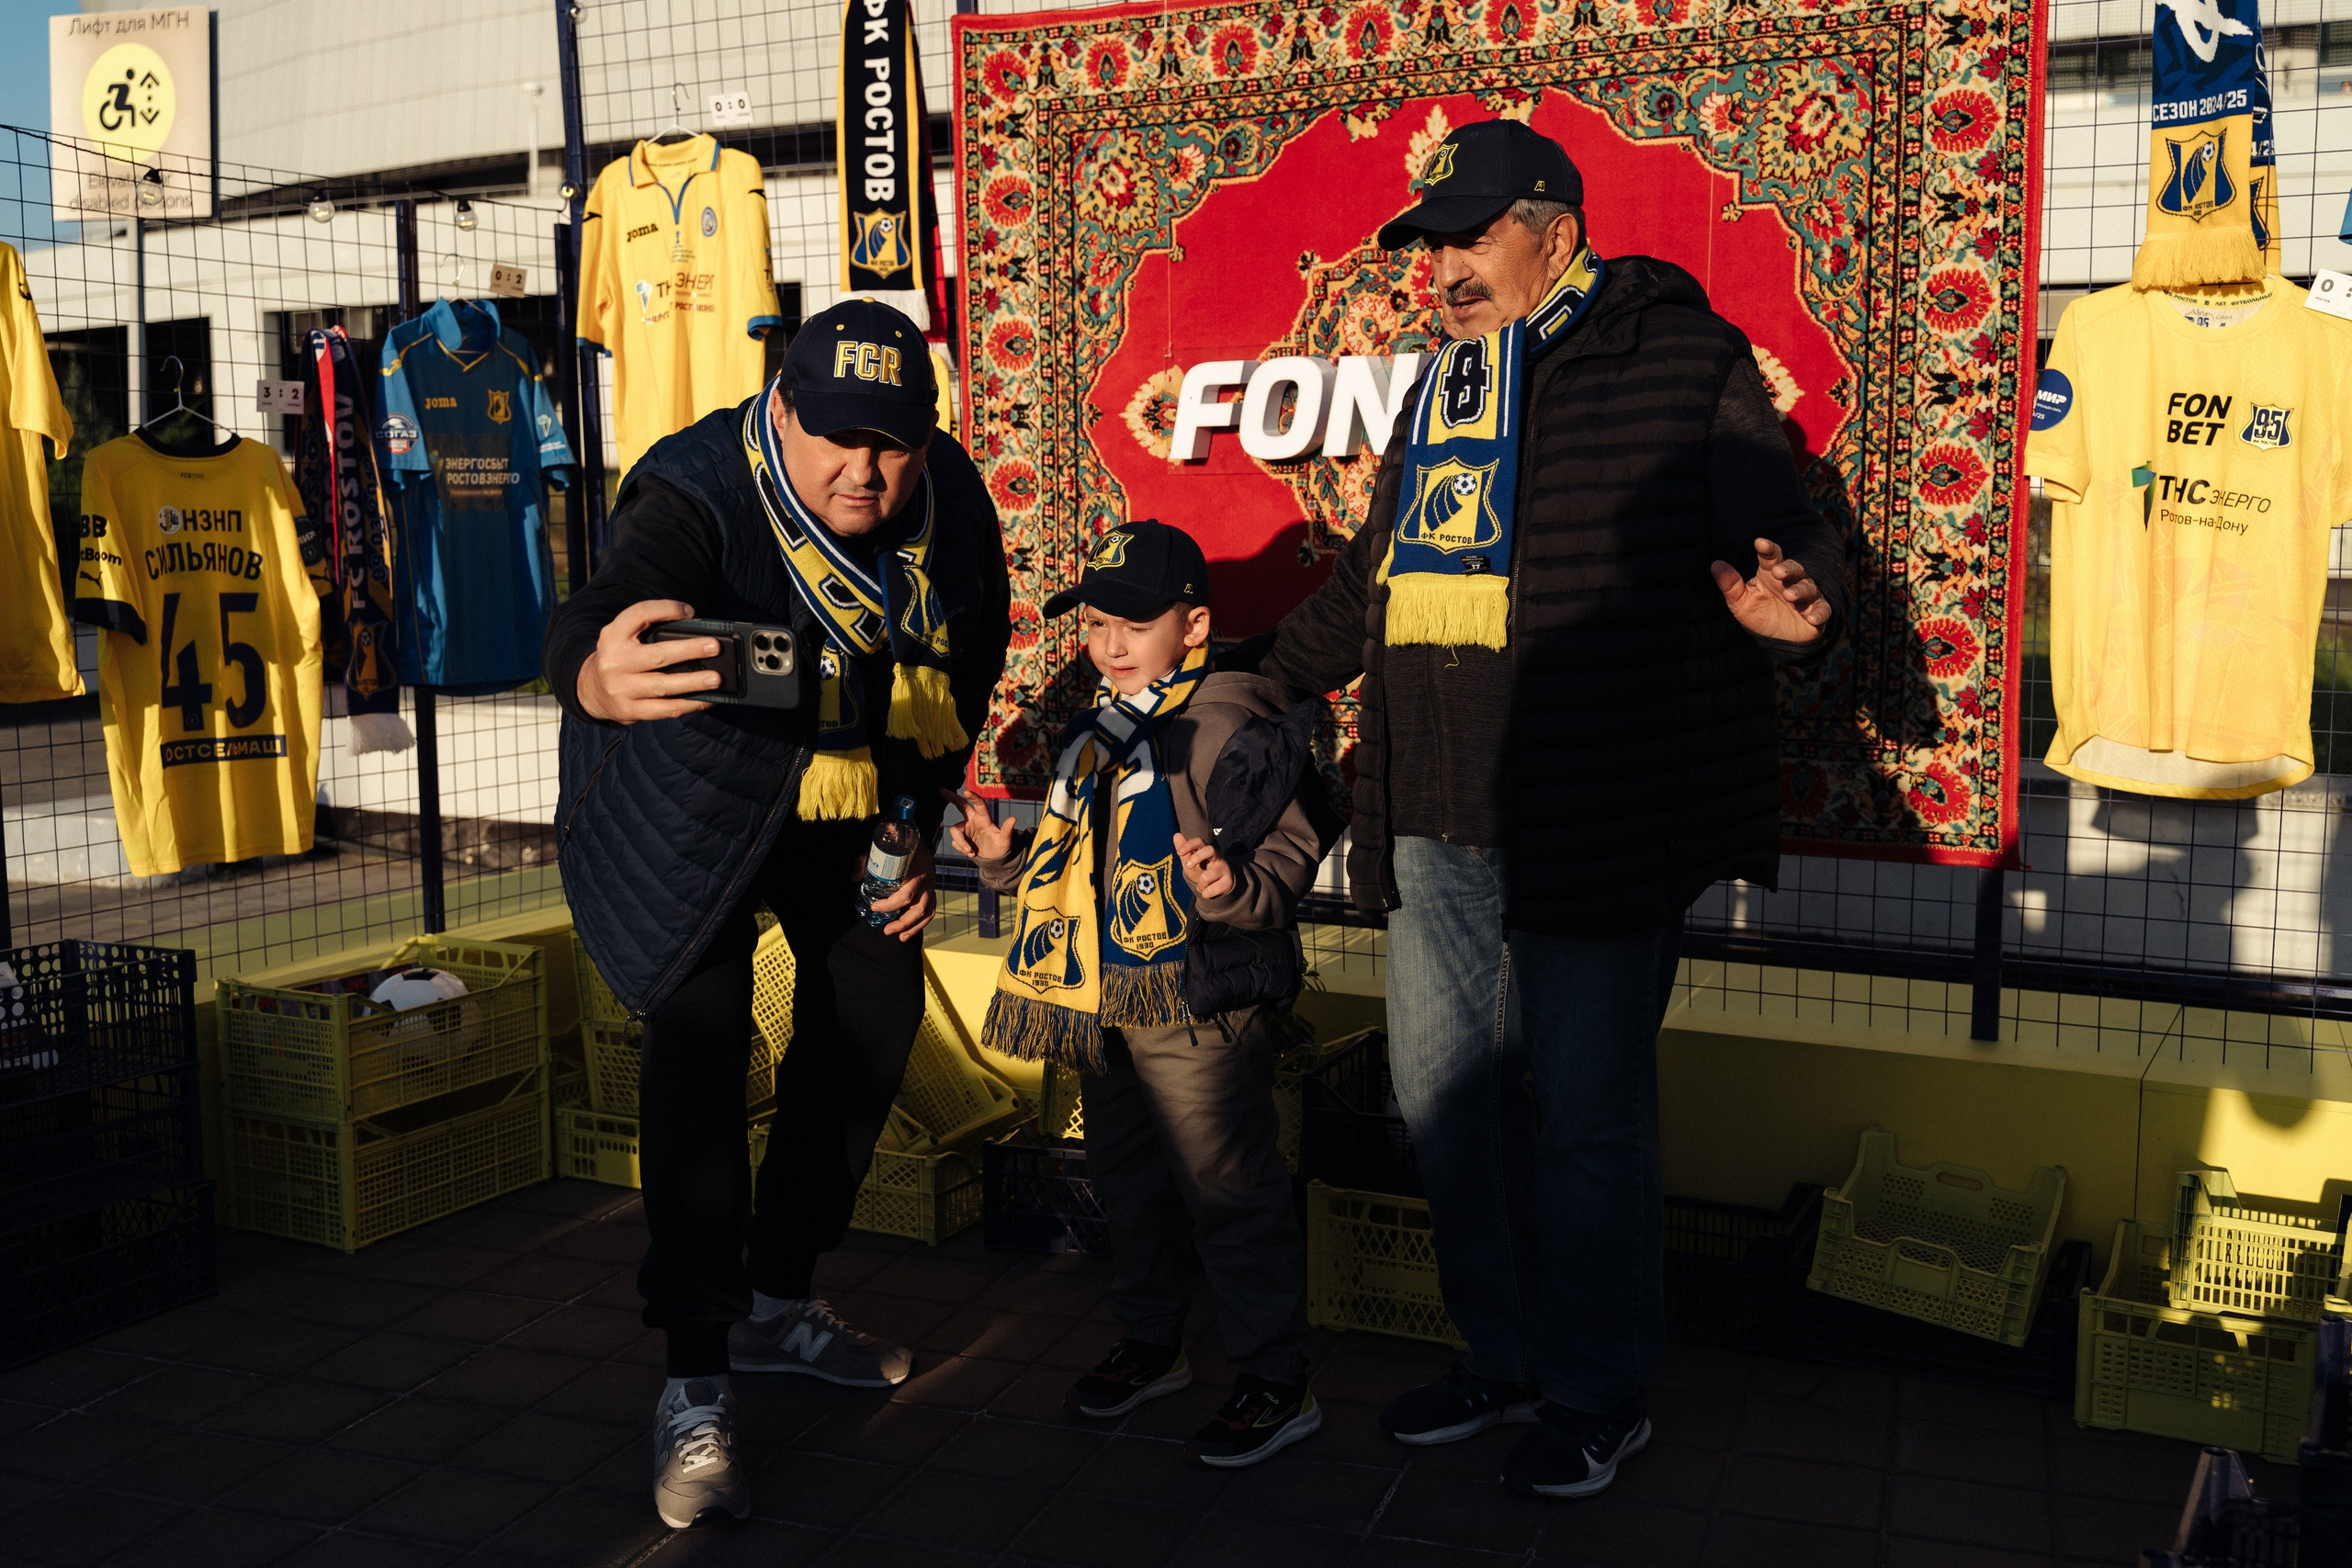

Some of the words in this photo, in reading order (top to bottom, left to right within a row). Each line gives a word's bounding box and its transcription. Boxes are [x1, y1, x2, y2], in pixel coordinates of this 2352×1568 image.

[69, 17, 111, 38] Лифт
[116, 18, 146, 35] для
[151, 11, 189, 29] МГН
[2152, 100, 2198, 122] СЕЗОН
[2199, 89, 2247, 117] 2024/25
[863, 58, 897, 202] РОСТОВ
[2174, 294, 2198, 304] РОСТОВ
[834, 341, 903, 386] FCR
[2036, 389, 2067, 405] МИР
[2168, 392, 2233, 420] FON
[375, 428, 419, 440] СОГАЗ
[2166, 420, 2225, 446] BET
[336, 393, 363, 555] ROSTOV
[445, 457, 510, 470] ЭНЕРГОСБЫТ
[446, 472, 521, 485] РОСТОВЭНЕРГО
[2158, 475, 2211, 505] ТНС
[2210, 490, 2272, 514] ЭНЕРГО
[183, 509, 242, 533] НЗНП
[1420, 532, 1436, 541] ФК
[1439, 534, 1473, 545] РОСТОВ
[144, 542, 264, 581] СИЛЬЯНОВ
[349, 562, 367, 610] FC
[161, 592, 267, 731] 45
[165, 739, 282, 762] ОСТСЕЛЬМАШ
[1123, 935, 1135, 943] ФК
[1136, 932, 1168, 942] РОСТОВ
[1019, 969, 1033, 978] ФК
[1035, 972, 1063, 982] РОСТОВ
[1261, 1391, 1280, 1405] FILA
